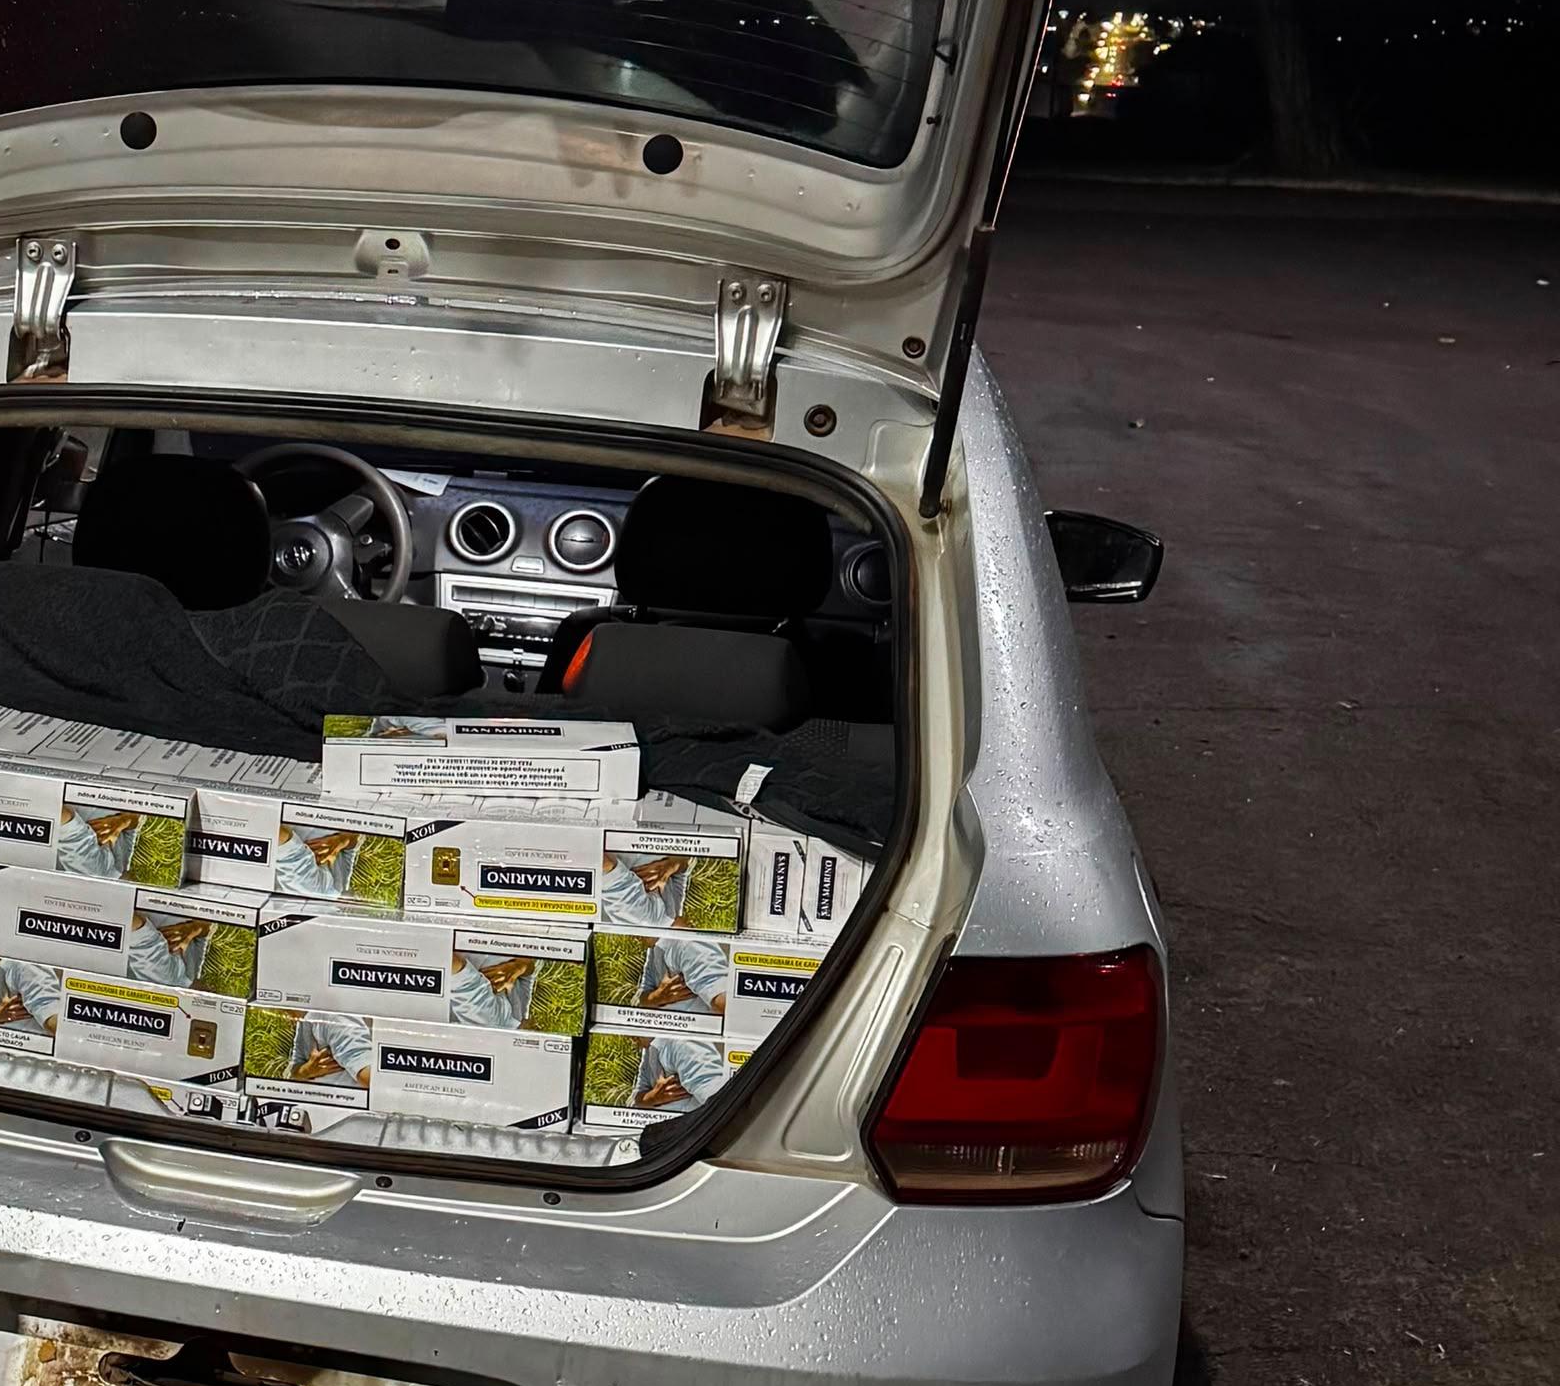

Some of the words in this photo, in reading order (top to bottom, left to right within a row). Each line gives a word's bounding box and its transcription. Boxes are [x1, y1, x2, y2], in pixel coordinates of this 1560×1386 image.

[16, 820, 46, 837] SAN
[411, 826, 435, 841] BOX
[193, 837, 230, 853] MARI
[233, 842, 262, 857] SAN
[487, 870, 551, 887] MARINO
[555, 873, 587, 889] SAN
[25, 916, 84, 938] MARINO
[264, 918, 288, 934] BOX
[87, 928, 116, 943] SAN
[338, 966, 402, 985] MARINO
[405, 972, 436, 988] SAN
[743, 978, 777, 993] SAN
[73, 1004, 103, 1019] SAN
[105, 1009, 165, 1030] MARINO
[387, 1052, 418, 1067] SAN
[422, 1056, 485, 1075] MARINO
[209, 1069, 233, 1083] BOX
[537, 1111, 563, 1127] BOX
